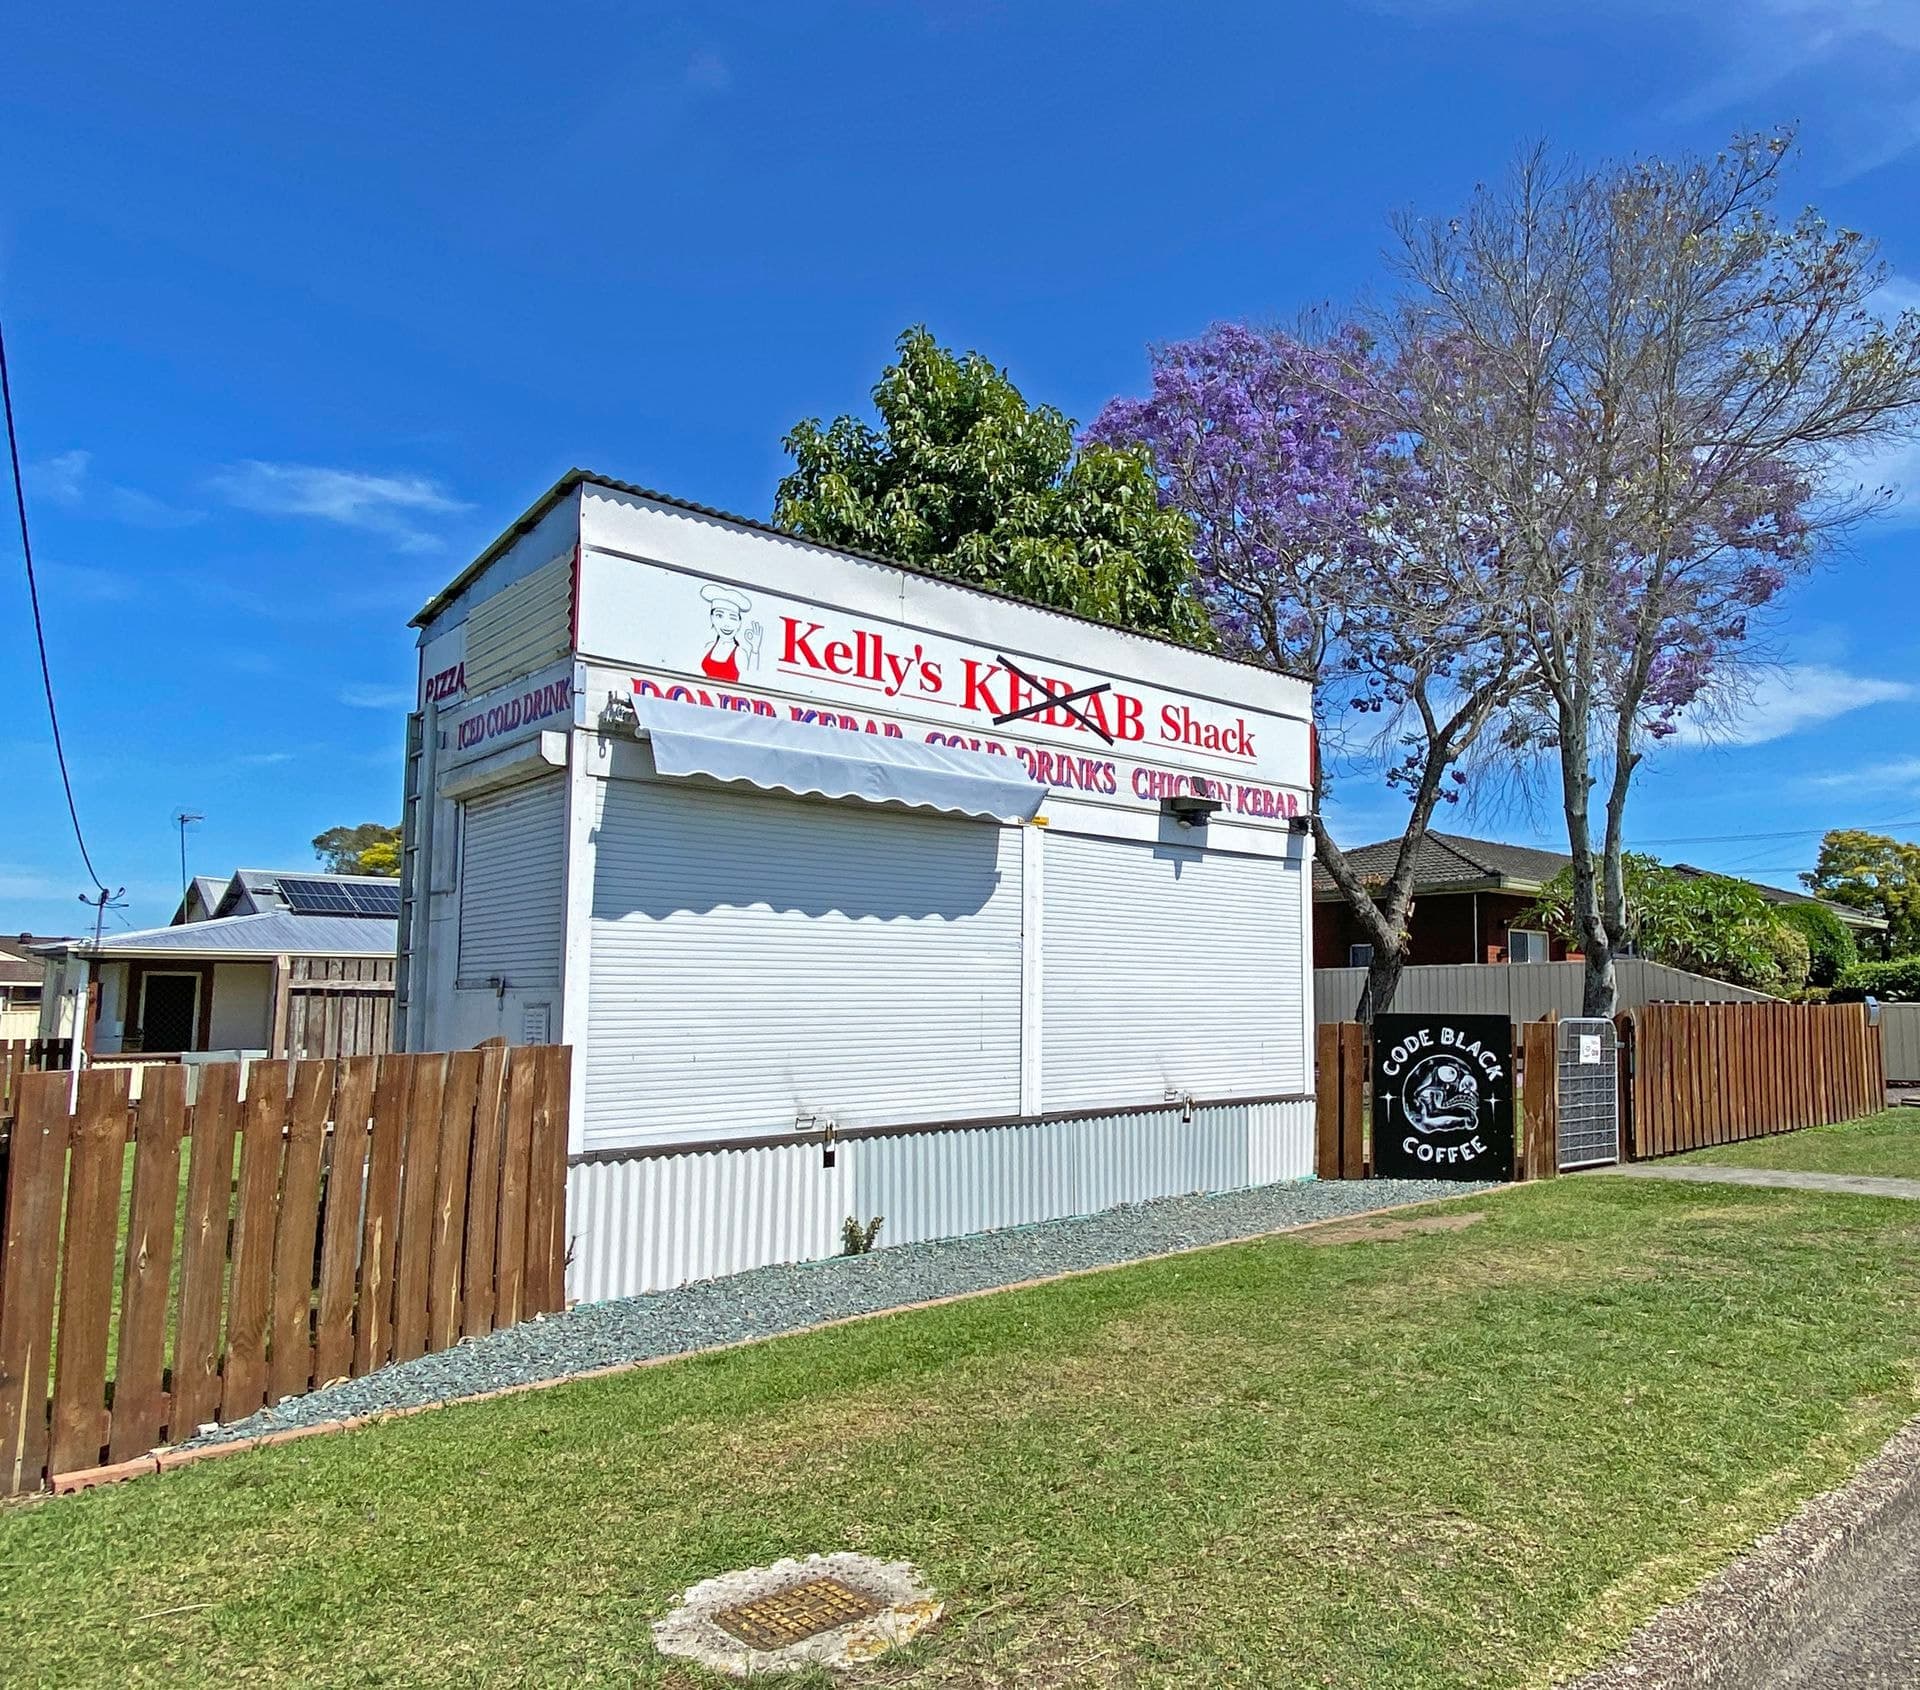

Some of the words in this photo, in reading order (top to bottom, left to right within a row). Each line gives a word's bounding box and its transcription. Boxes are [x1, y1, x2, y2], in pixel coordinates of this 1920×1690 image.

[425, 661, 466, 703] PIZZA
[778, 616, 943, 697] Kelly's
[959, 658, 1145, 741] KEBAB
[1160, 704, 1258, 758] Shack
[457, 714, 485, 751] ICED
[486, 698, 522, 738] COLD
[1015, 746, 1117, 795] DRINKS
[1236, 785, 1299, 820] KEBAB
[1383, 1029, 1434, 1076] CODE
[1440, 1027, 1504, 1082] BLACK
[1402, 1135, 1488, 1164] COFFEE
